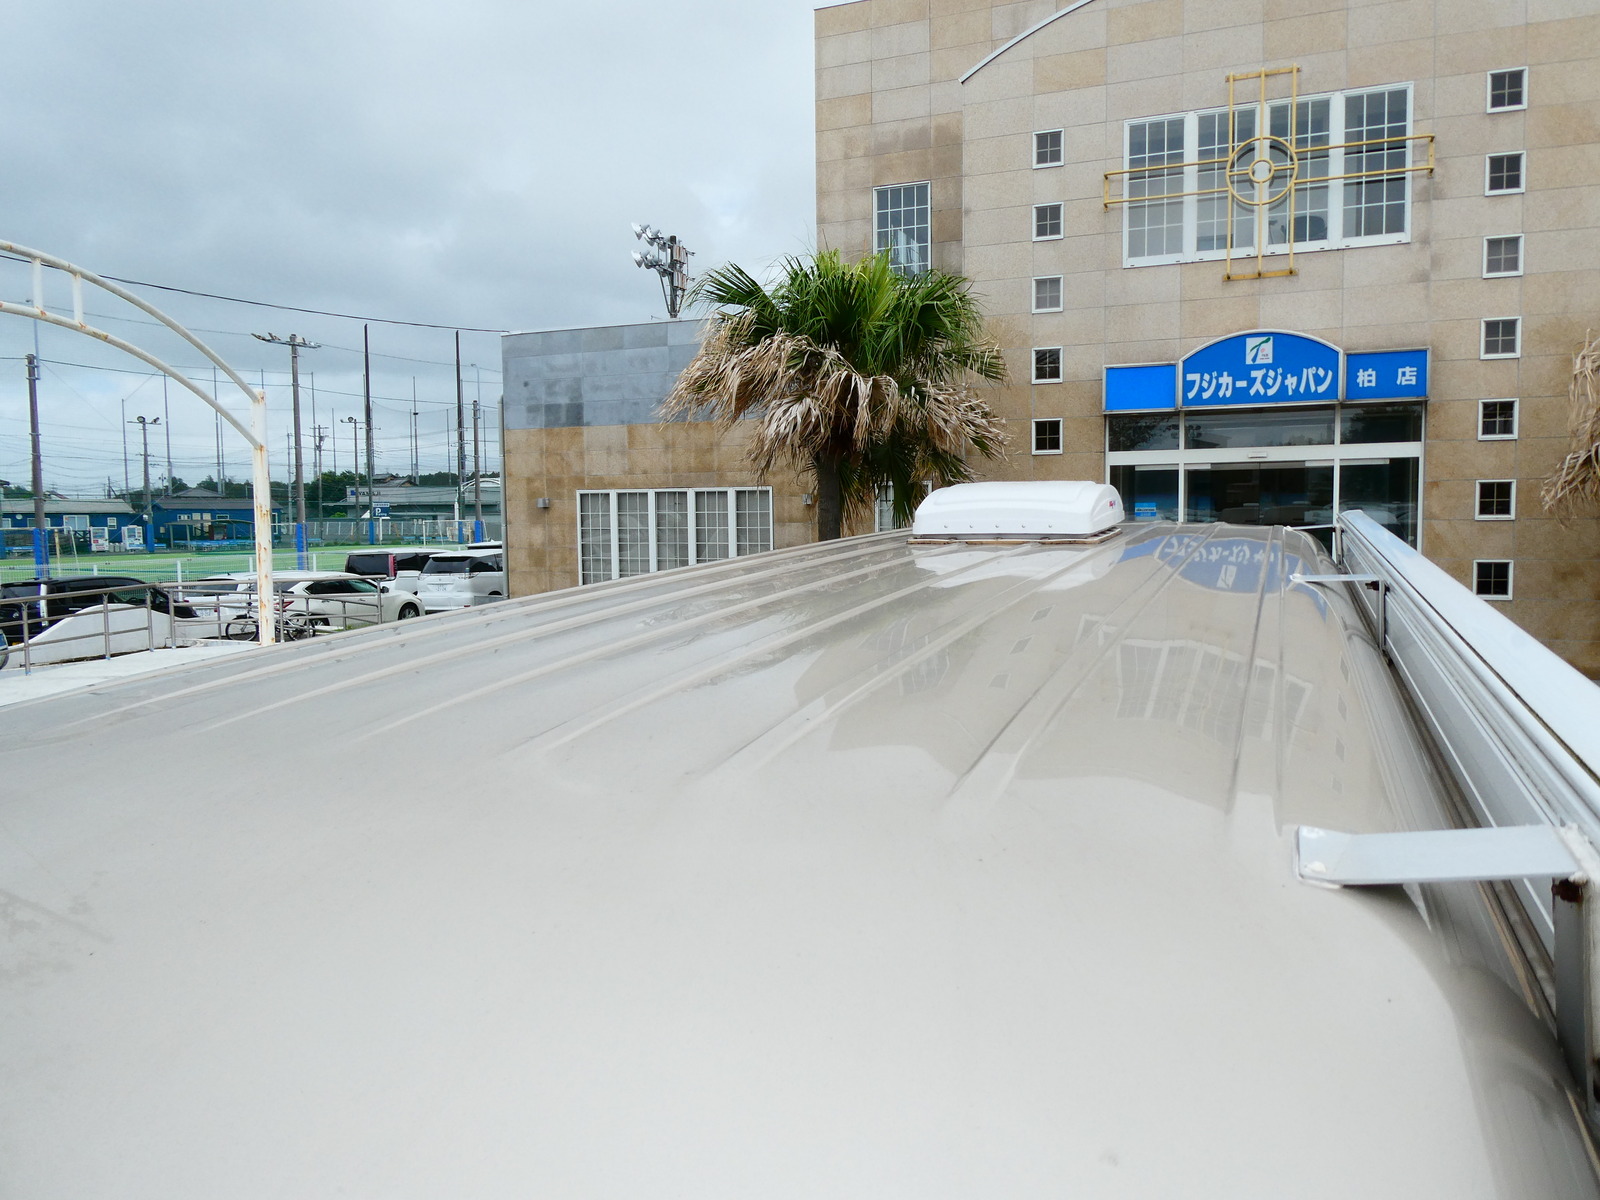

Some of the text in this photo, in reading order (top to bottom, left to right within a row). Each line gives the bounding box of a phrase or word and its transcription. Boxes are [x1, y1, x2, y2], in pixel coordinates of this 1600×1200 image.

[1186, 367, 1333, 399] フジカーズジャパン
